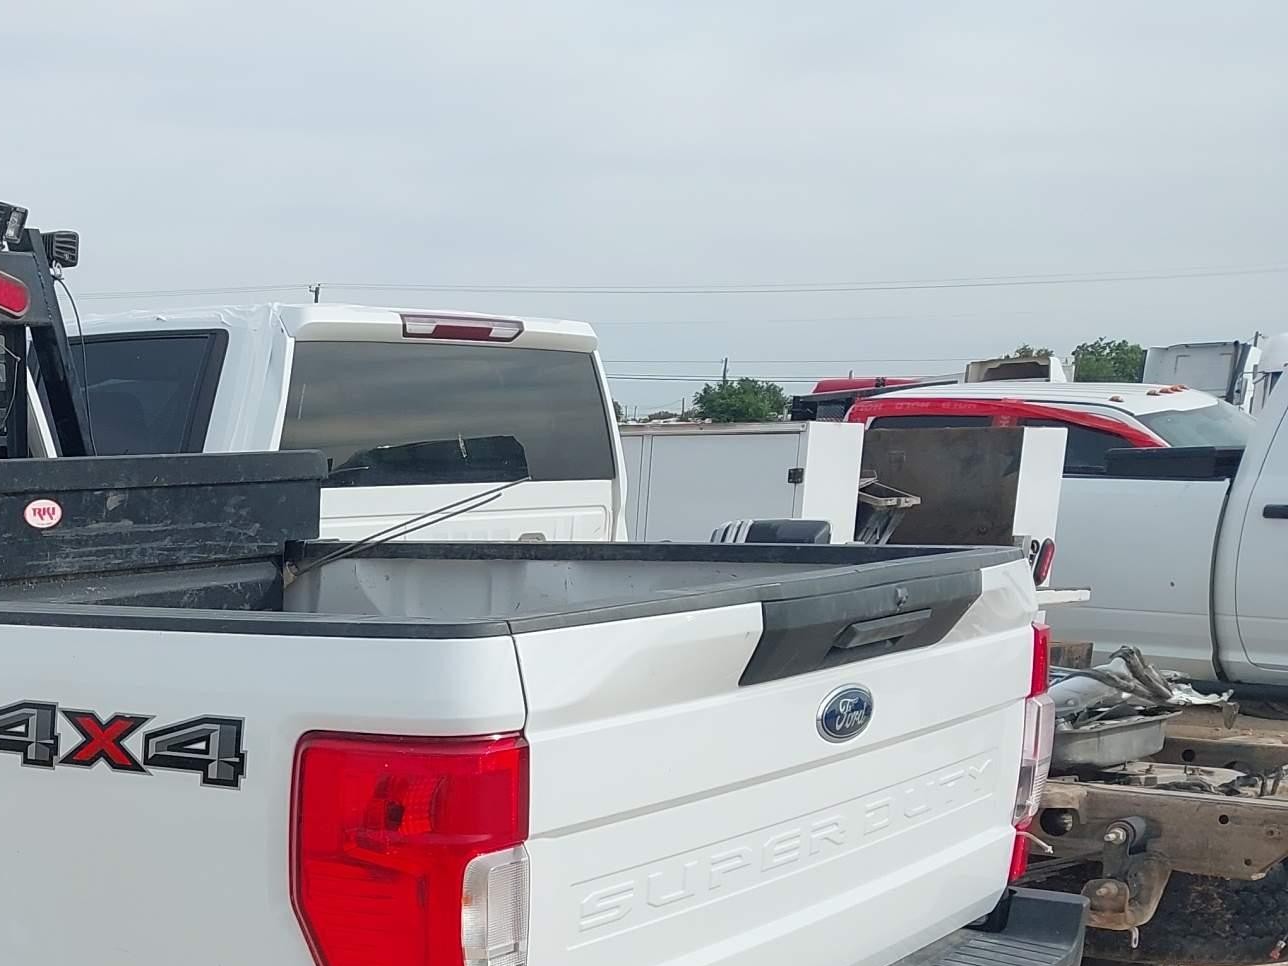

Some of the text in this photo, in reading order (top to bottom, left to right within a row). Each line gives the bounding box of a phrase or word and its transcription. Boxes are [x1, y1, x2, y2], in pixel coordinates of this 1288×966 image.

[835, 696, 868, 731] Ford
[578, 757, 993, 932] SUPER DUTY
